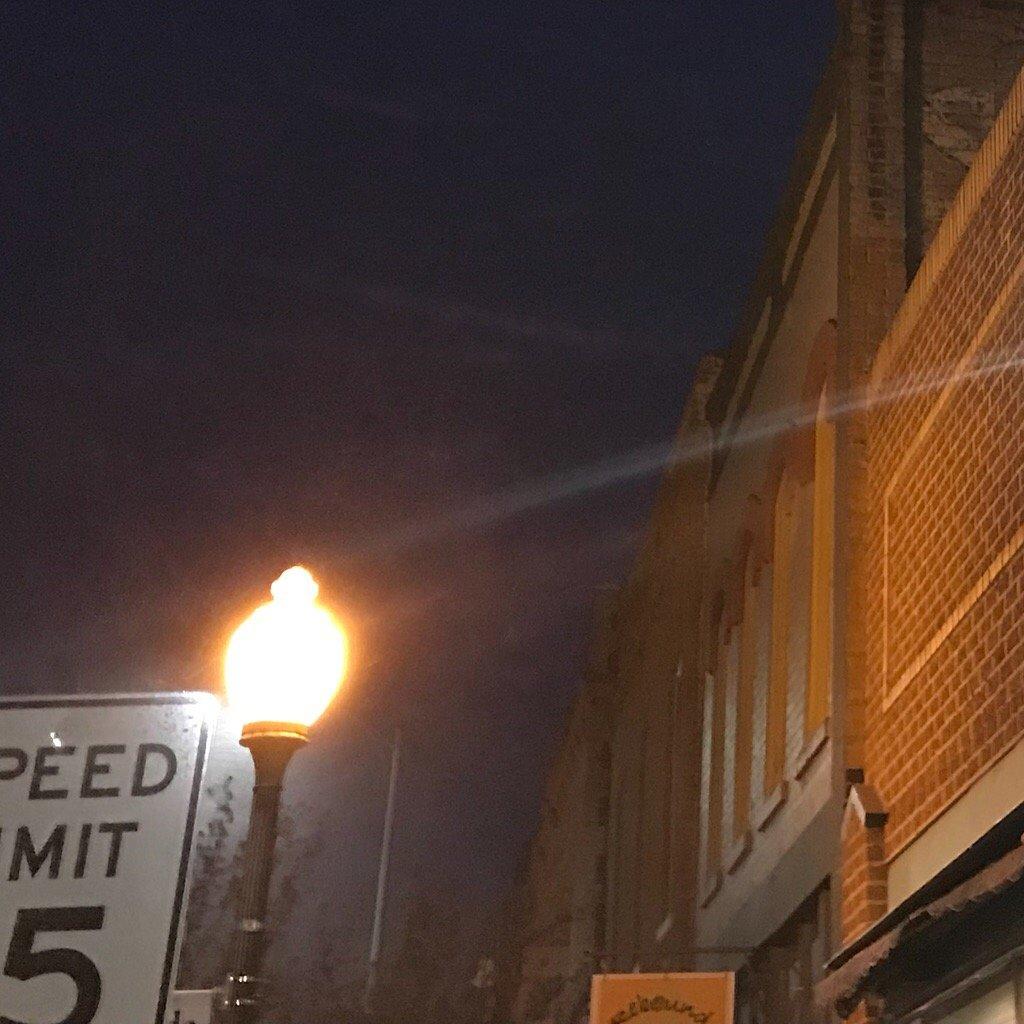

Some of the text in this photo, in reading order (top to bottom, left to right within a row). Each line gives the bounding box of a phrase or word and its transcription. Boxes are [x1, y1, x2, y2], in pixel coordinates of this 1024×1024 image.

[0, 742, 178, 801] PEED
[0, 821, 139, 882] MIT
[0, 905, 106, 1024] 5
